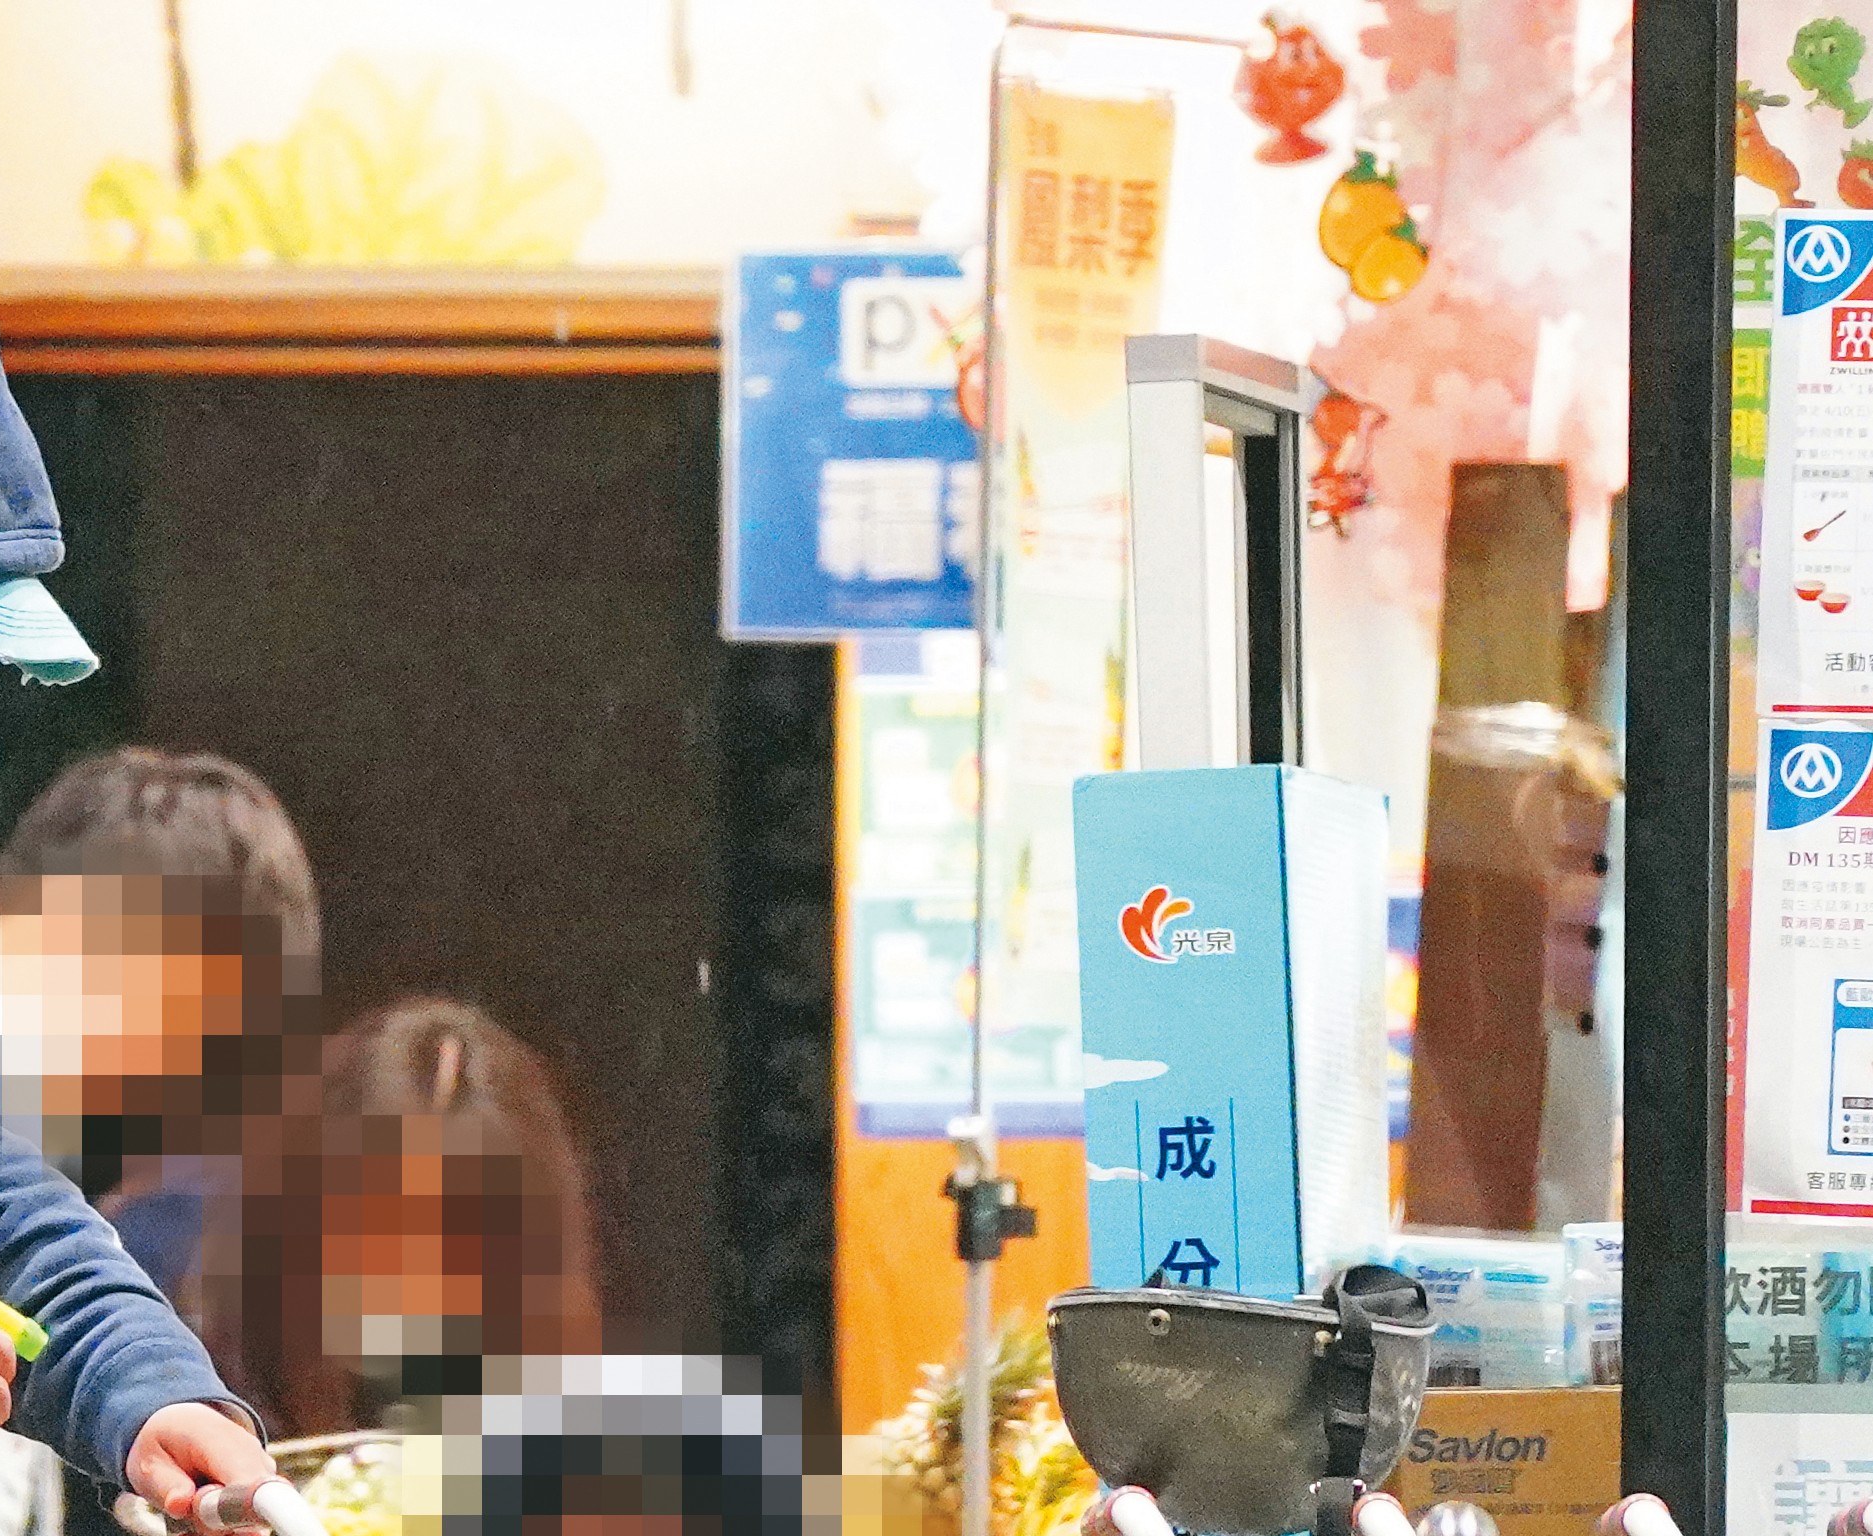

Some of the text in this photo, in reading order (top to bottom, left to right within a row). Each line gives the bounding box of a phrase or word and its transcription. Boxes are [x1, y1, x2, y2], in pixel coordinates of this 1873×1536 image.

[1825, 652, 1873, 672] 活動
[1788, 851, 1818, 866] DM
[1171, 931, 1234, 952] 光泉
[1807, 1171, 1873, 1190] 客服專
[1408, 1428, 1547, 1463] Savlon
